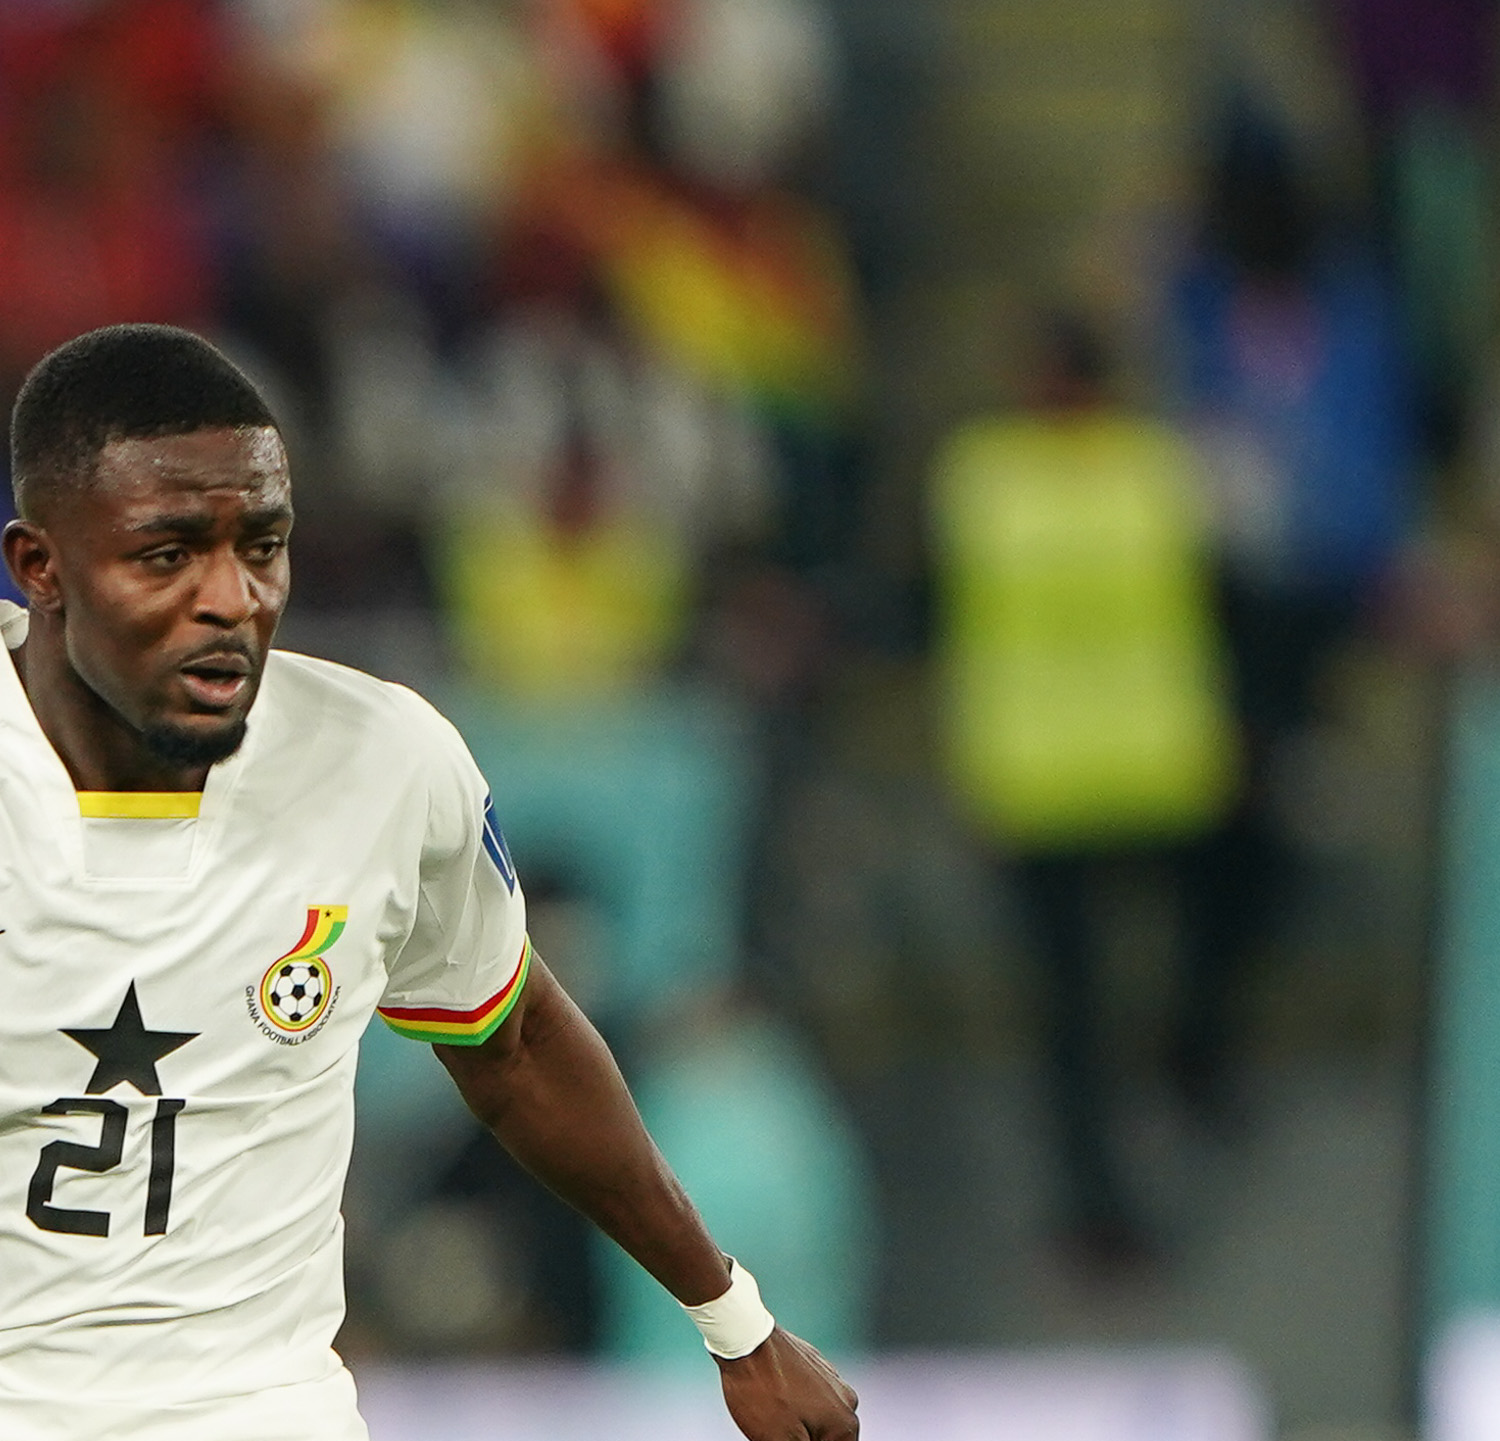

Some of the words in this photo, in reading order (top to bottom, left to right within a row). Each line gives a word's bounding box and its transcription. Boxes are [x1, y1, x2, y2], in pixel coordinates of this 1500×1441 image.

[245, 985, 261, 1025] GHANA
[257, 1021, 300, 1047] FOOTBALL
[25, 1096, 187, 1239] 21
